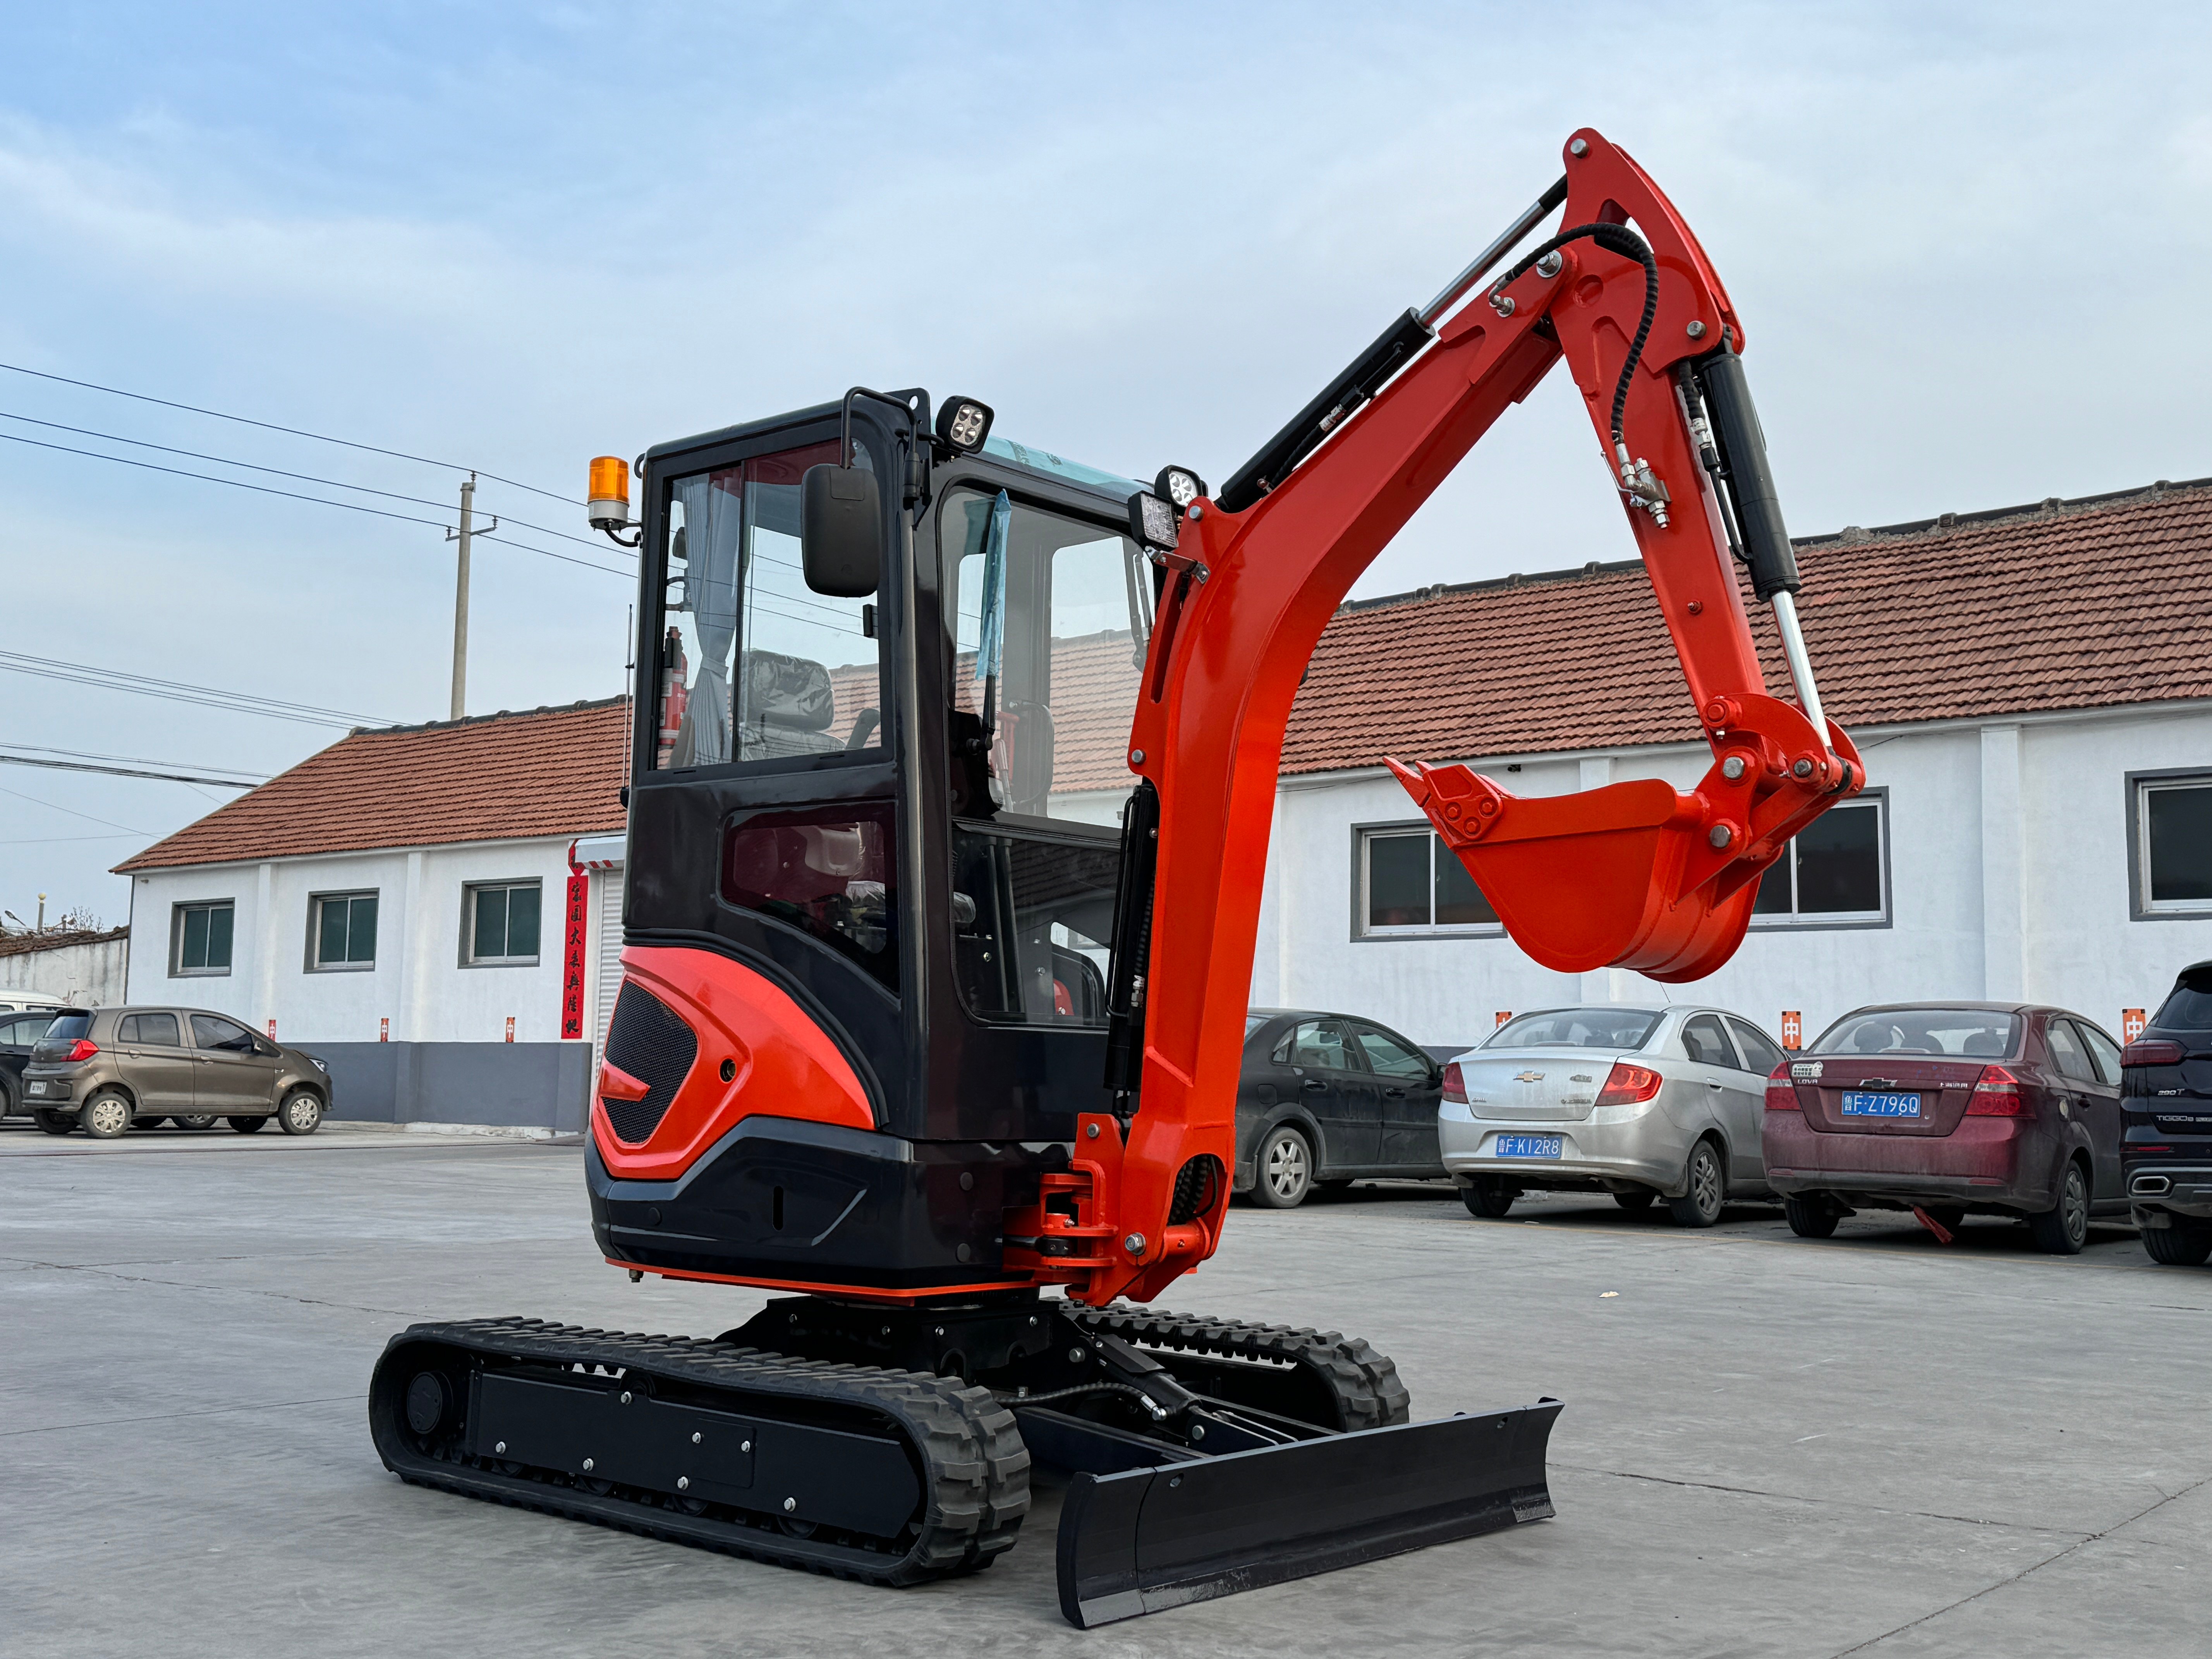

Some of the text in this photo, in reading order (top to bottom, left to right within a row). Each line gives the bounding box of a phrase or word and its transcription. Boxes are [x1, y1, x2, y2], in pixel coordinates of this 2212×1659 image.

[381, 1022, 387, 1038] 中
[507, 1021, 514, 1038] 中
[1784, 1017, 1799, 1044] 中
[2126, 1015, 2143, 1041] 中
